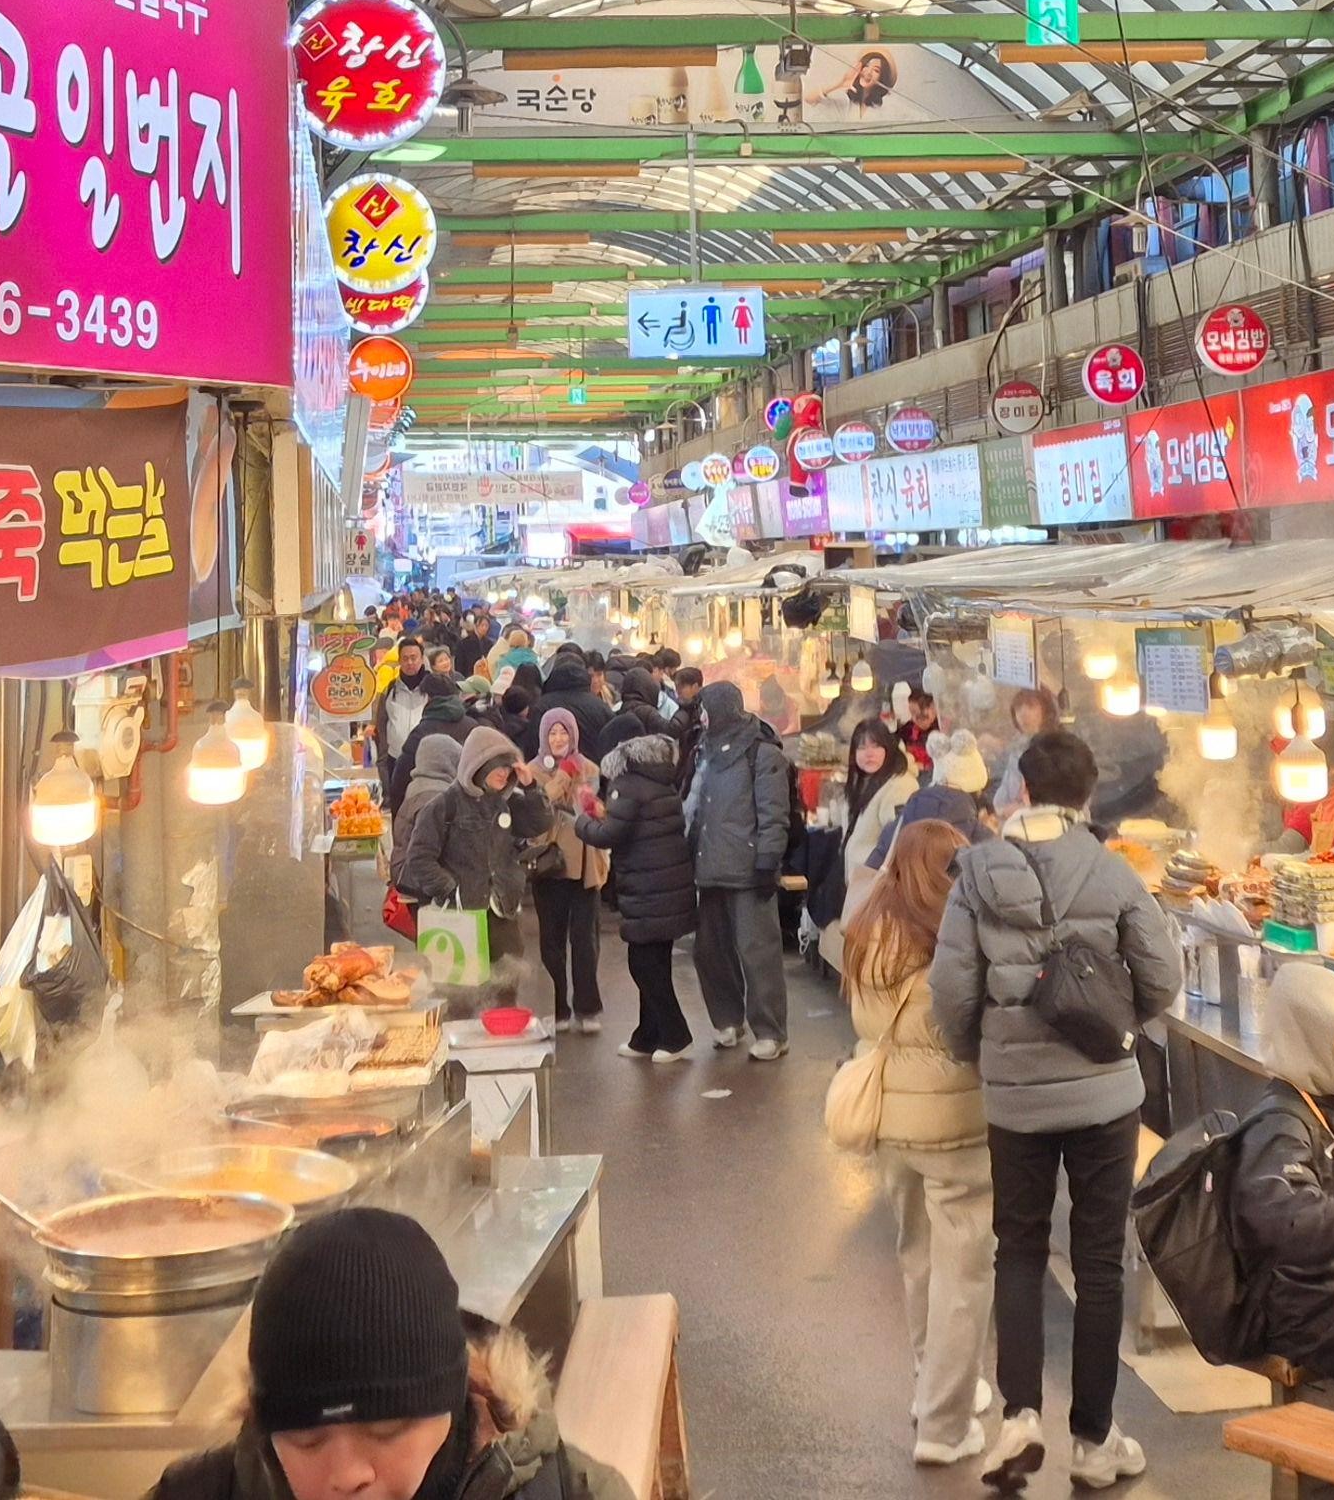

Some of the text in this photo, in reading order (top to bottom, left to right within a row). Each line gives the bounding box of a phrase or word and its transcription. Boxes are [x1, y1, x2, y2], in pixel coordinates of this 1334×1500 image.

[337, 22, 432, 69] 창신
[517, 85, 597, 113] 국순당
[341, 229, 423, 268] 창신
[1206, 328, 1266, 352] 모녀김밥
[1095, 367, 1137, 393] 육회
[999, 404, 1040, 419] 장미집
[1167, 427, 1229, 486] 모녀김밥
[1059, 458, 1103, 506] 장미집
[52, 460, 175, 591] 먹는날
